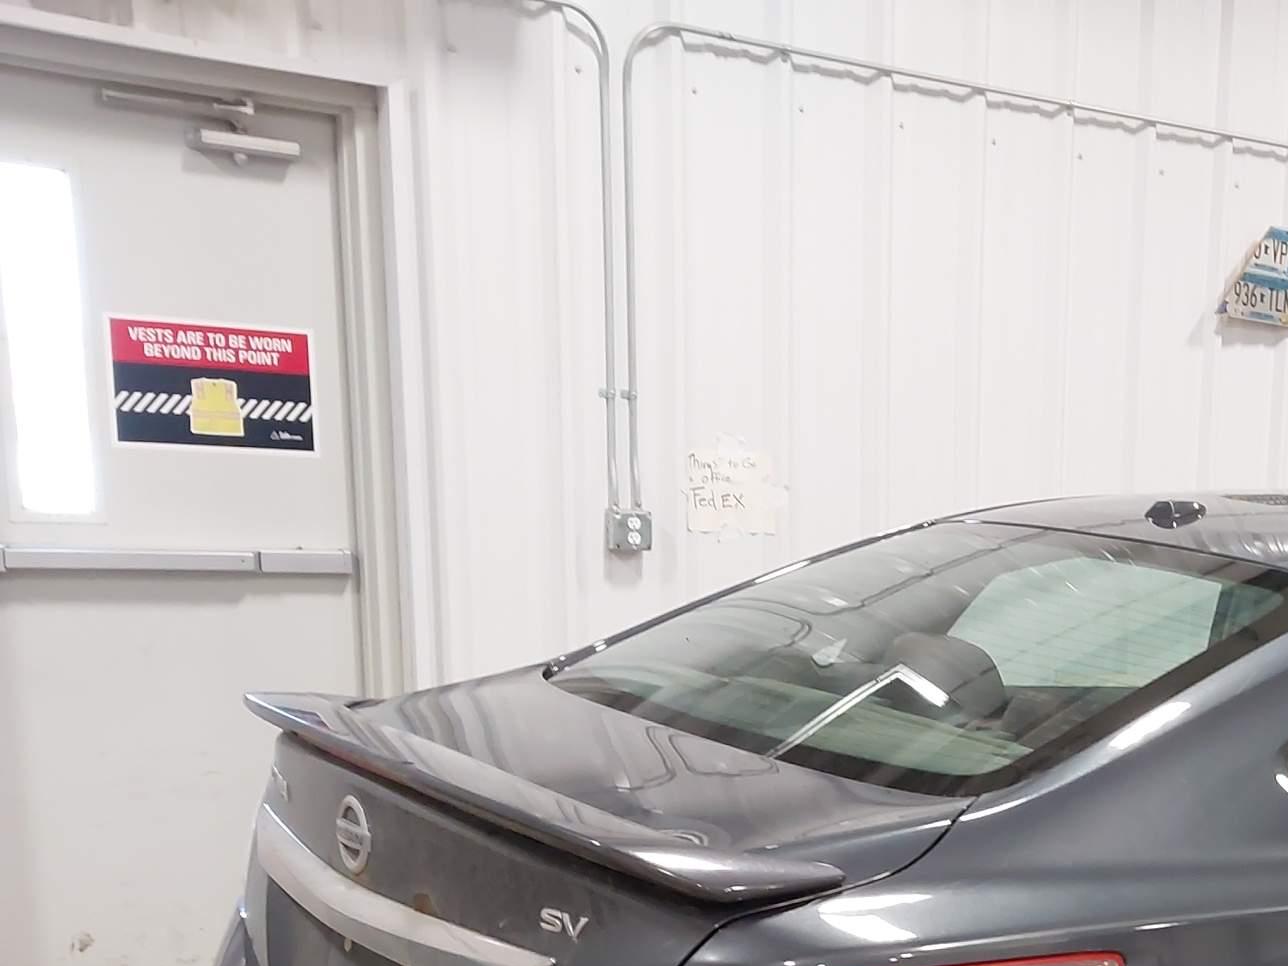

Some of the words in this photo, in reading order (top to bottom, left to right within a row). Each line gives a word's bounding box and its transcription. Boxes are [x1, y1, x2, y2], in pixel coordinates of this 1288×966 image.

[128, 326, 174, 344] VESTS
[176, 330, 205, 346] ARE
[206, 332, 226, 348] TO
[228, 334, 247, 350] BE
[249, 336, 292, 353] WORN
[143, 343, 201, 361] BEYOND
[203, 347, 236, 363] THIS
[239, 350, 281, 367] POINT
[540, 908, 589, 940] SV
